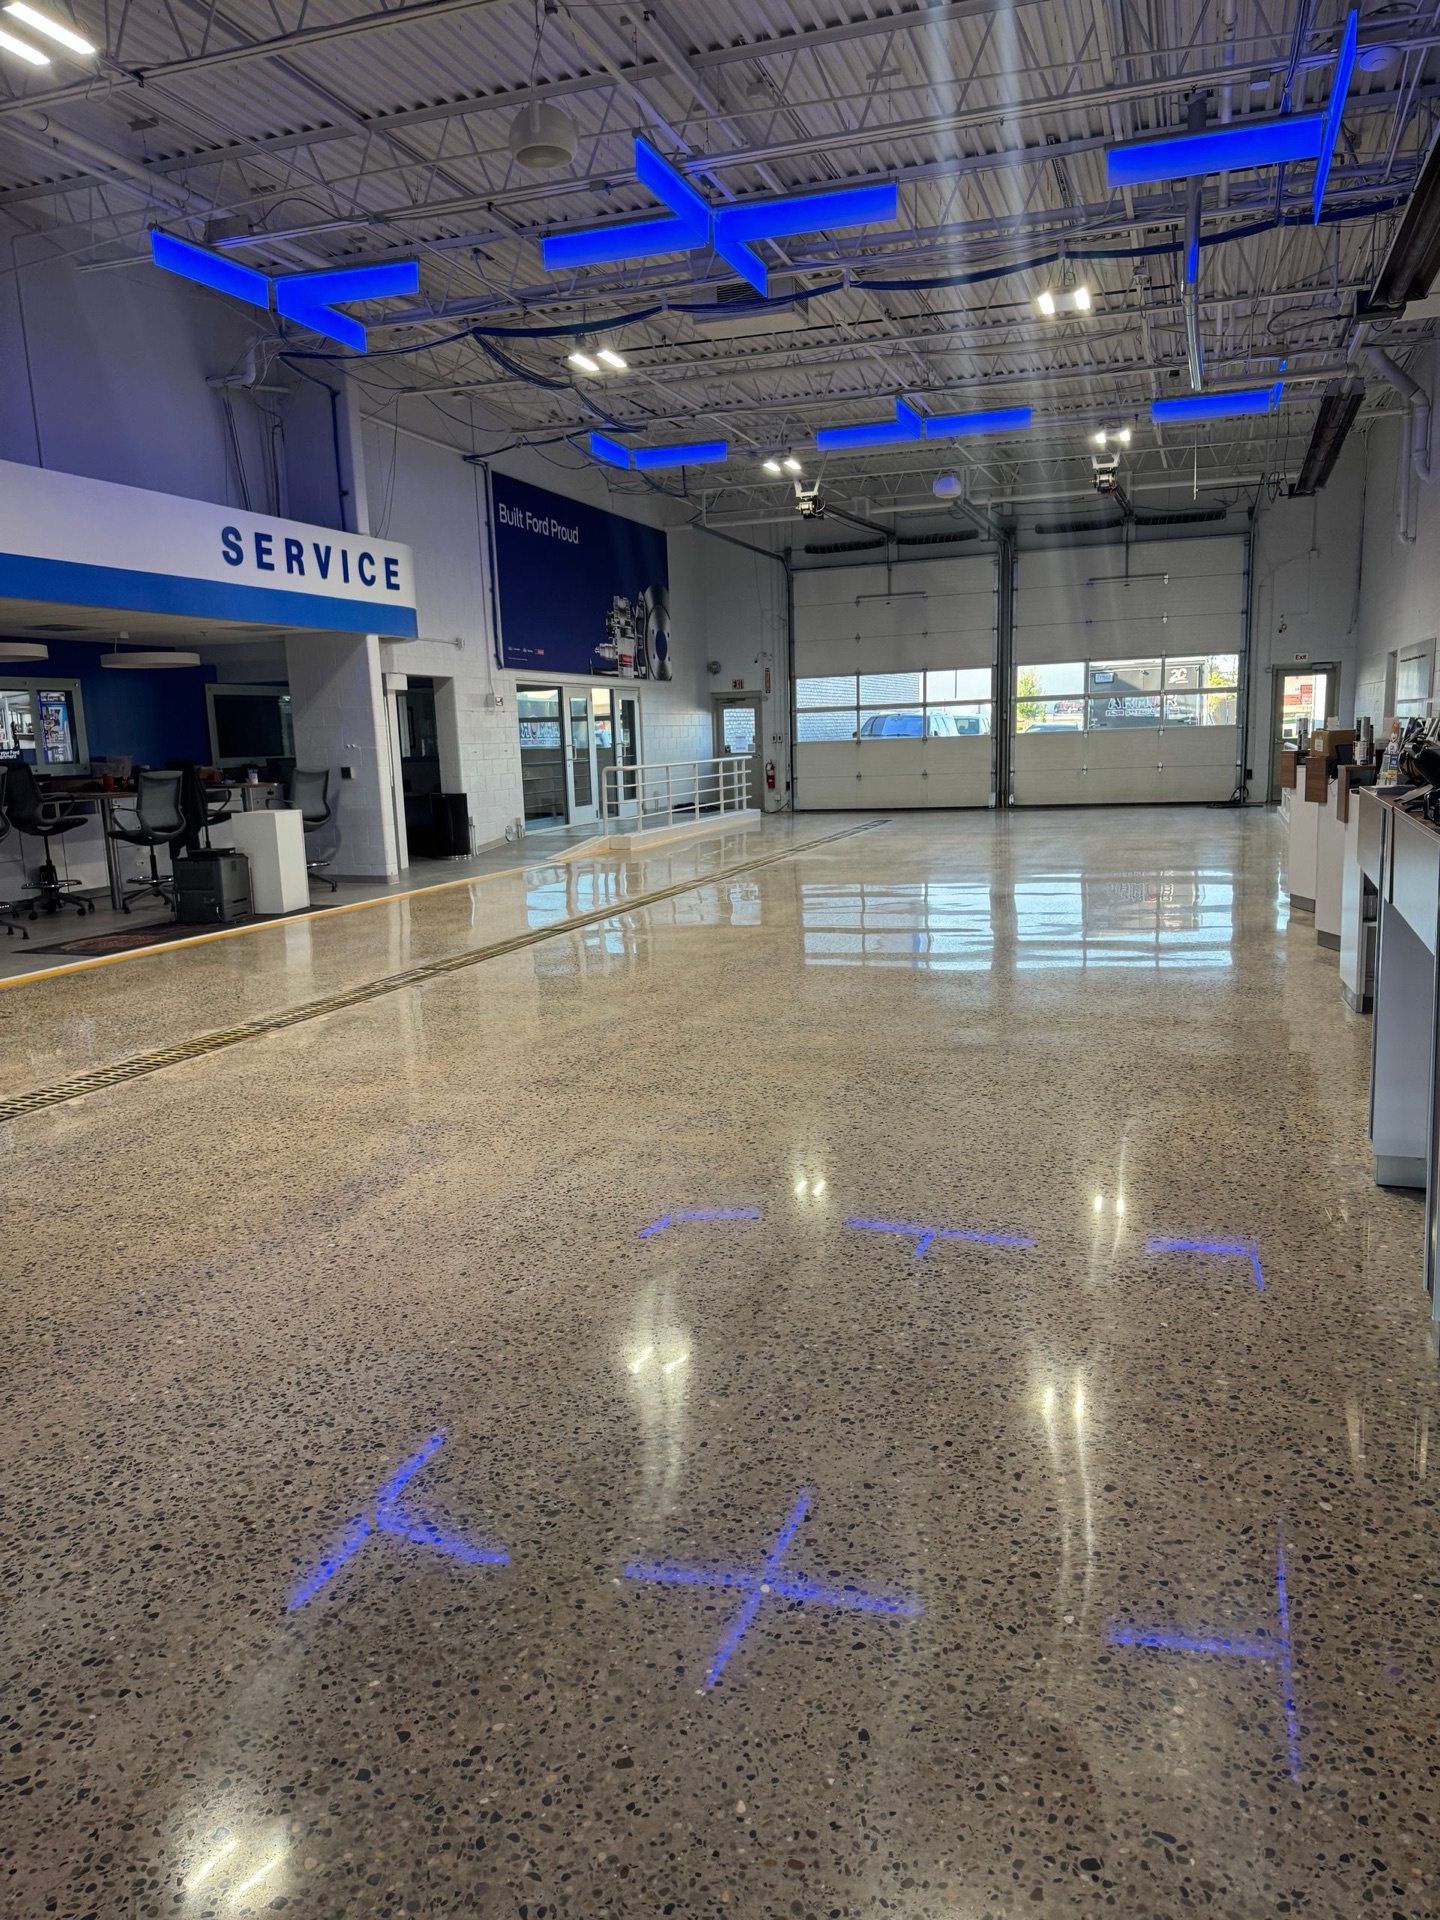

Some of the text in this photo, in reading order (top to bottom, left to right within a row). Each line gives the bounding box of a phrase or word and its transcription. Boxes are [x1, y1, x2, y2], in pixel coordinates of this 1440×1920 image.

[499, 502, 579, 544] Built Ford Proud
[221, 525, 401, 591] SERVICE
